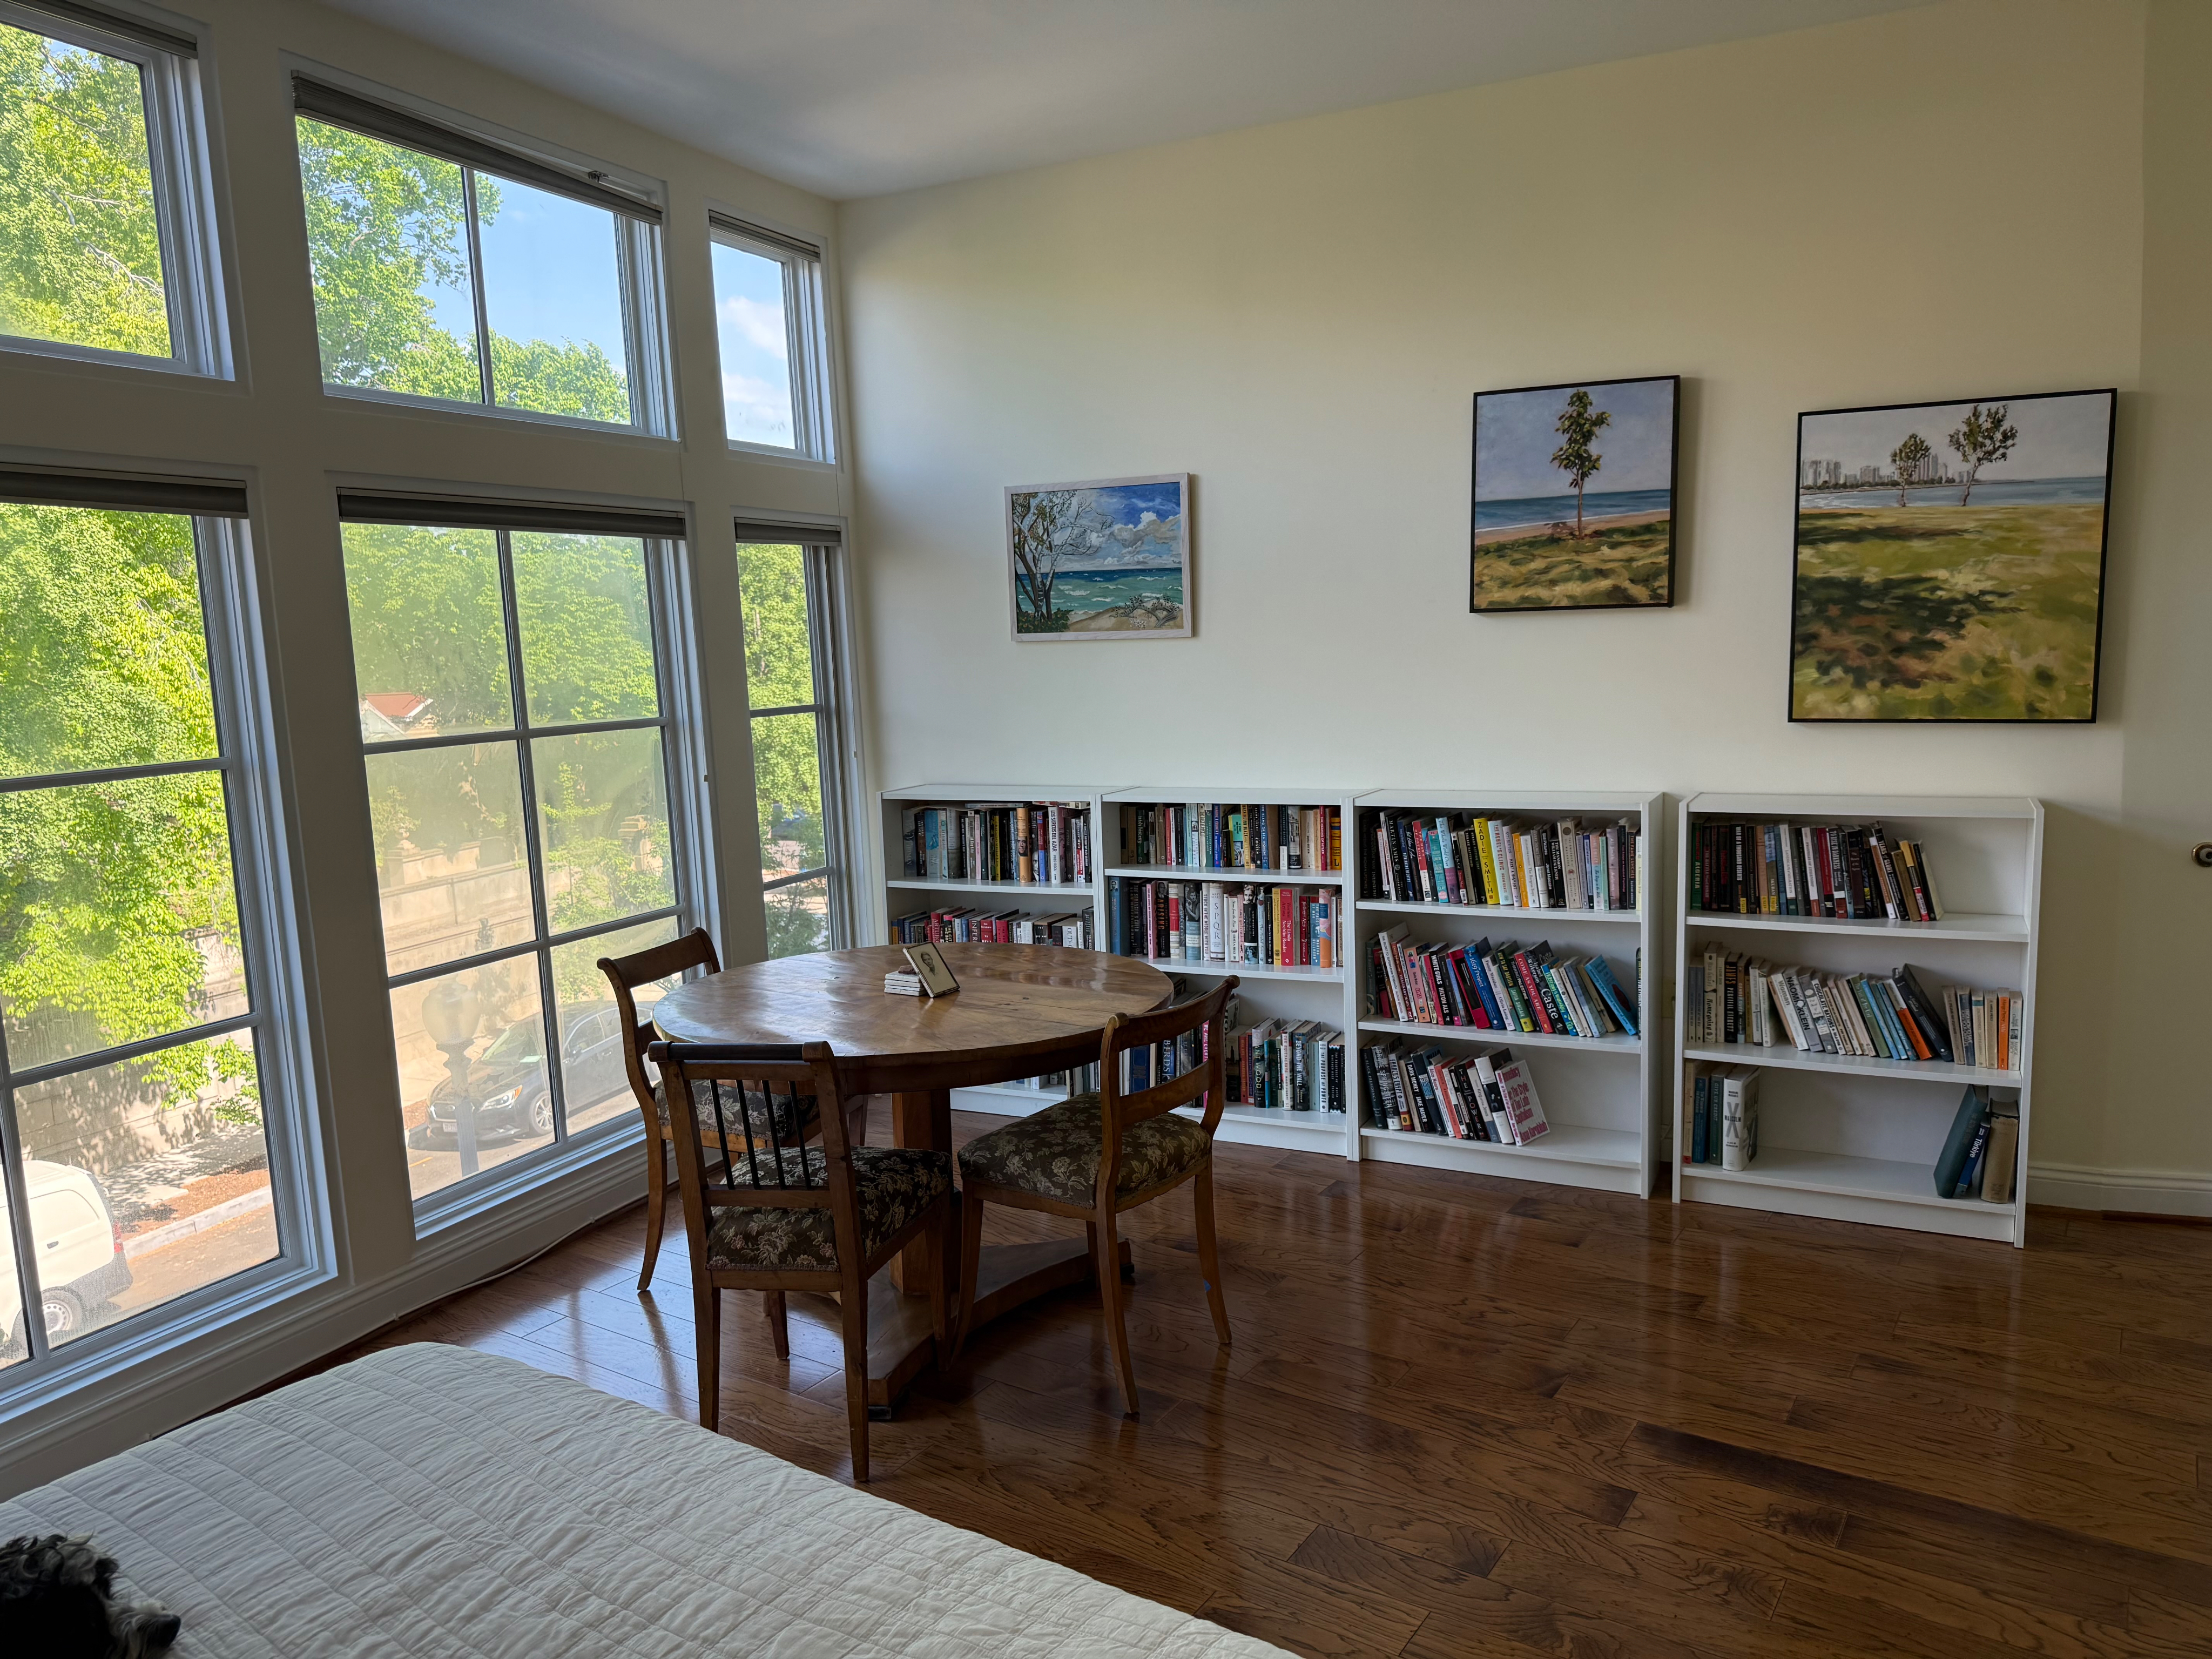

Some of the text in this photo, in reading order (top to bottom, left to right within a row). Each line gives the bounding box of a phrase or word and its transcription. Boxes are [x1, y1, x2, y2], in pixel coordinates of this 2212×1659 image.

[1478, 822, 1494, 894] ZADIE SMITH
[1832, 850, 1840, 869] DARKNESS
[1878, 840, 1886, 854] YEARS
[1884, 859, 1893, 873] GLORY
[1431, 955, 1440, 970] WHITE
[1469, 958, 1478, 970] 1619
[1474, 970, 1484, 987] Project
[1527, 958, 1540, 983] Wilkerson
[1534, 962, 1543, 977] Isabel
[1490, 972, 1498, 988] Weather
[1505, 971, 1514, 986] BABYLON
[1518, 958, 1527, 975] COME
[1533, 998, 1541, 1011] ARE
[1725, 966, 1736, 984] JAMES
[1438, 987, 1446, 1004] HILTON
[1518, 979, 1528, 1000] PALESTINE
[1778, 980, 1791, 1006] Woman
[1515, 1001, 1525, 1017] SINCLAIR
[1541, 988, 1559, 1019] Caste
[1814, 983, 1835, 1028] CHOCOLATE NATIONS
[1705, 999, 1714, 1030] Homegoing
[1796, 1007, 1810, 1030] KLEIN
[1376, 1050, 1392, 1108] BRUCE SPRINGSTEEN
[1390, 1059, 1399, 1079] FRANCO'S
[1411, 1077, 1419, 1092] MONEY
[1419, 1107, 1427, 1122] MAYER
